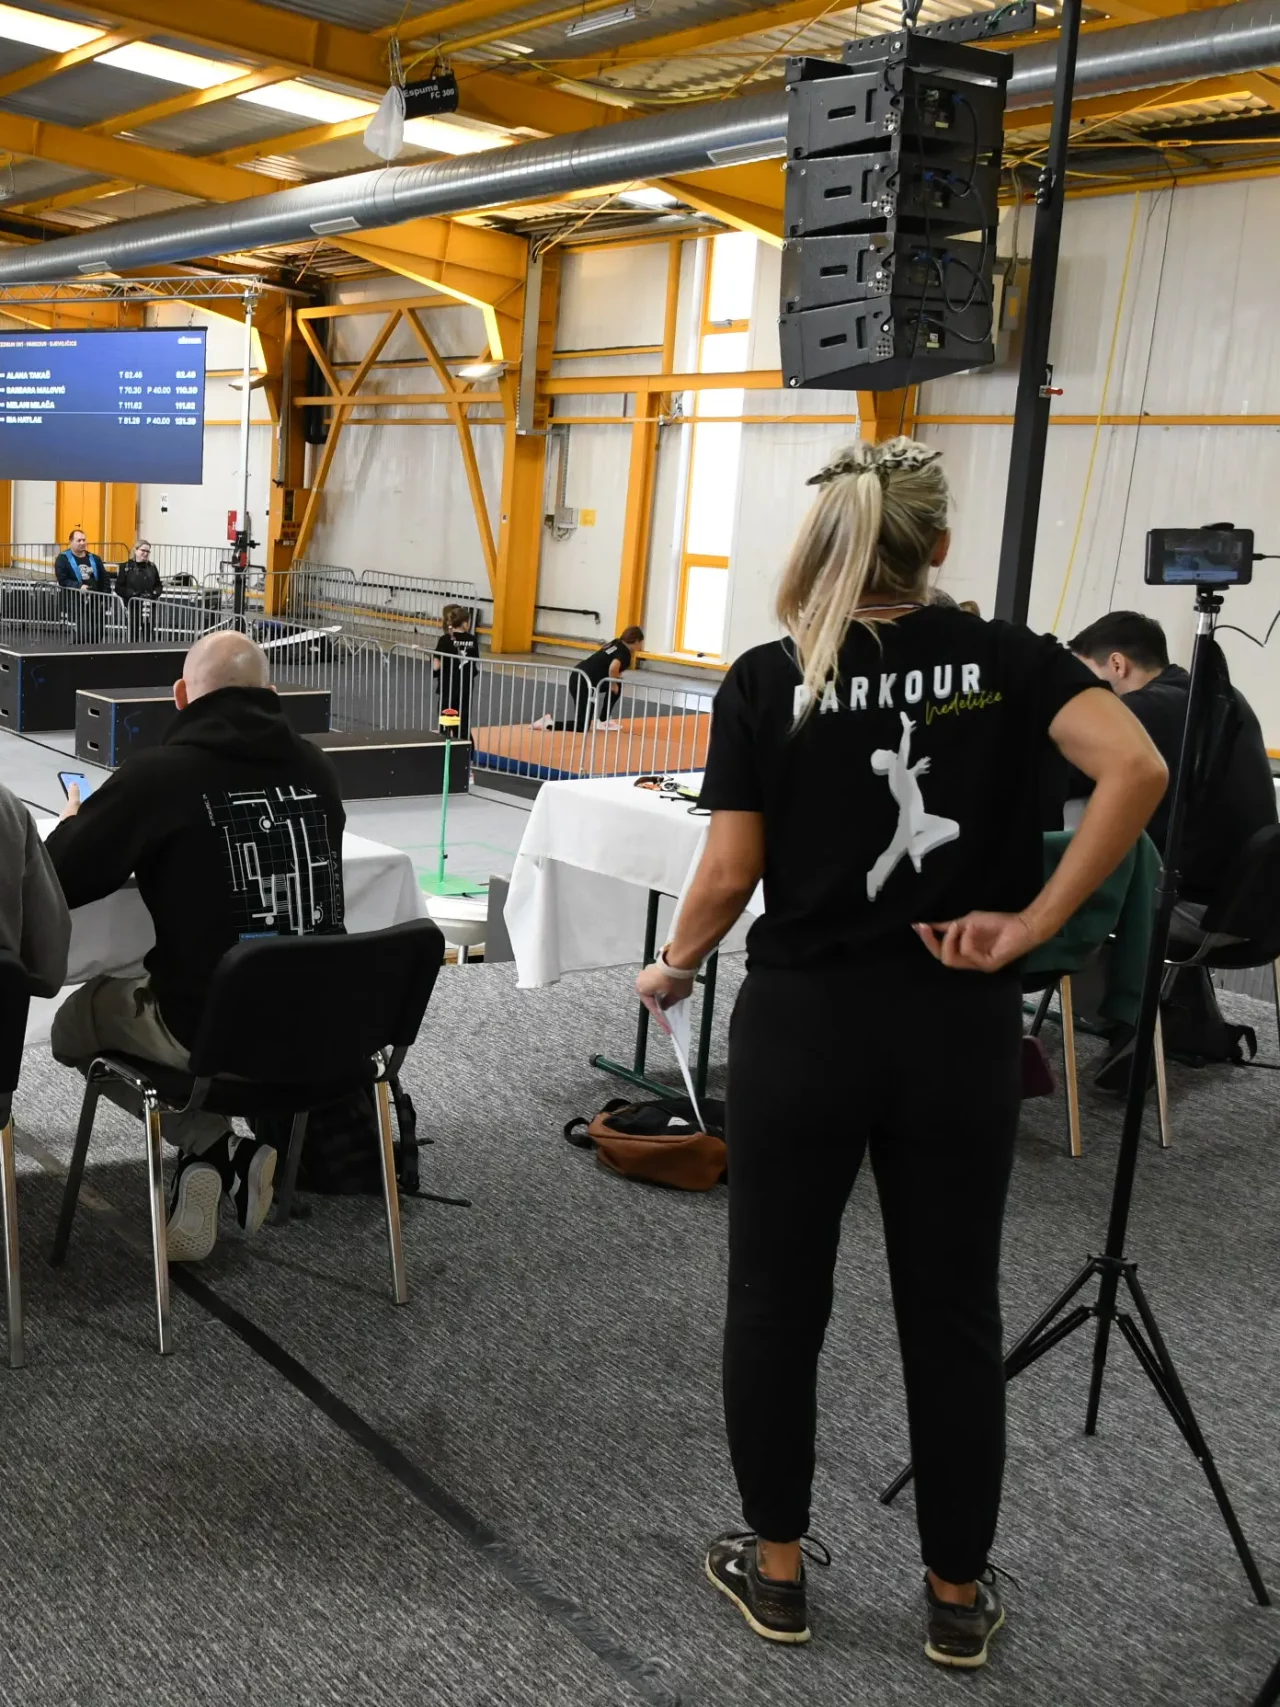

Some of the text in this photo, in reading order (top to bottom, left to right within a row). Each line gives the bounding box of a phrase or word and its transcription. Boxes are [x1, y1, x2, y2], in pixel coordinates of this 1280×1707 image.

[403, 84, 438, 97] Espuma
[430, 88, 455, 99] FC 300
[153, 386, 171, 394] 40.00
[152, 417, 170, 425] 40.00
